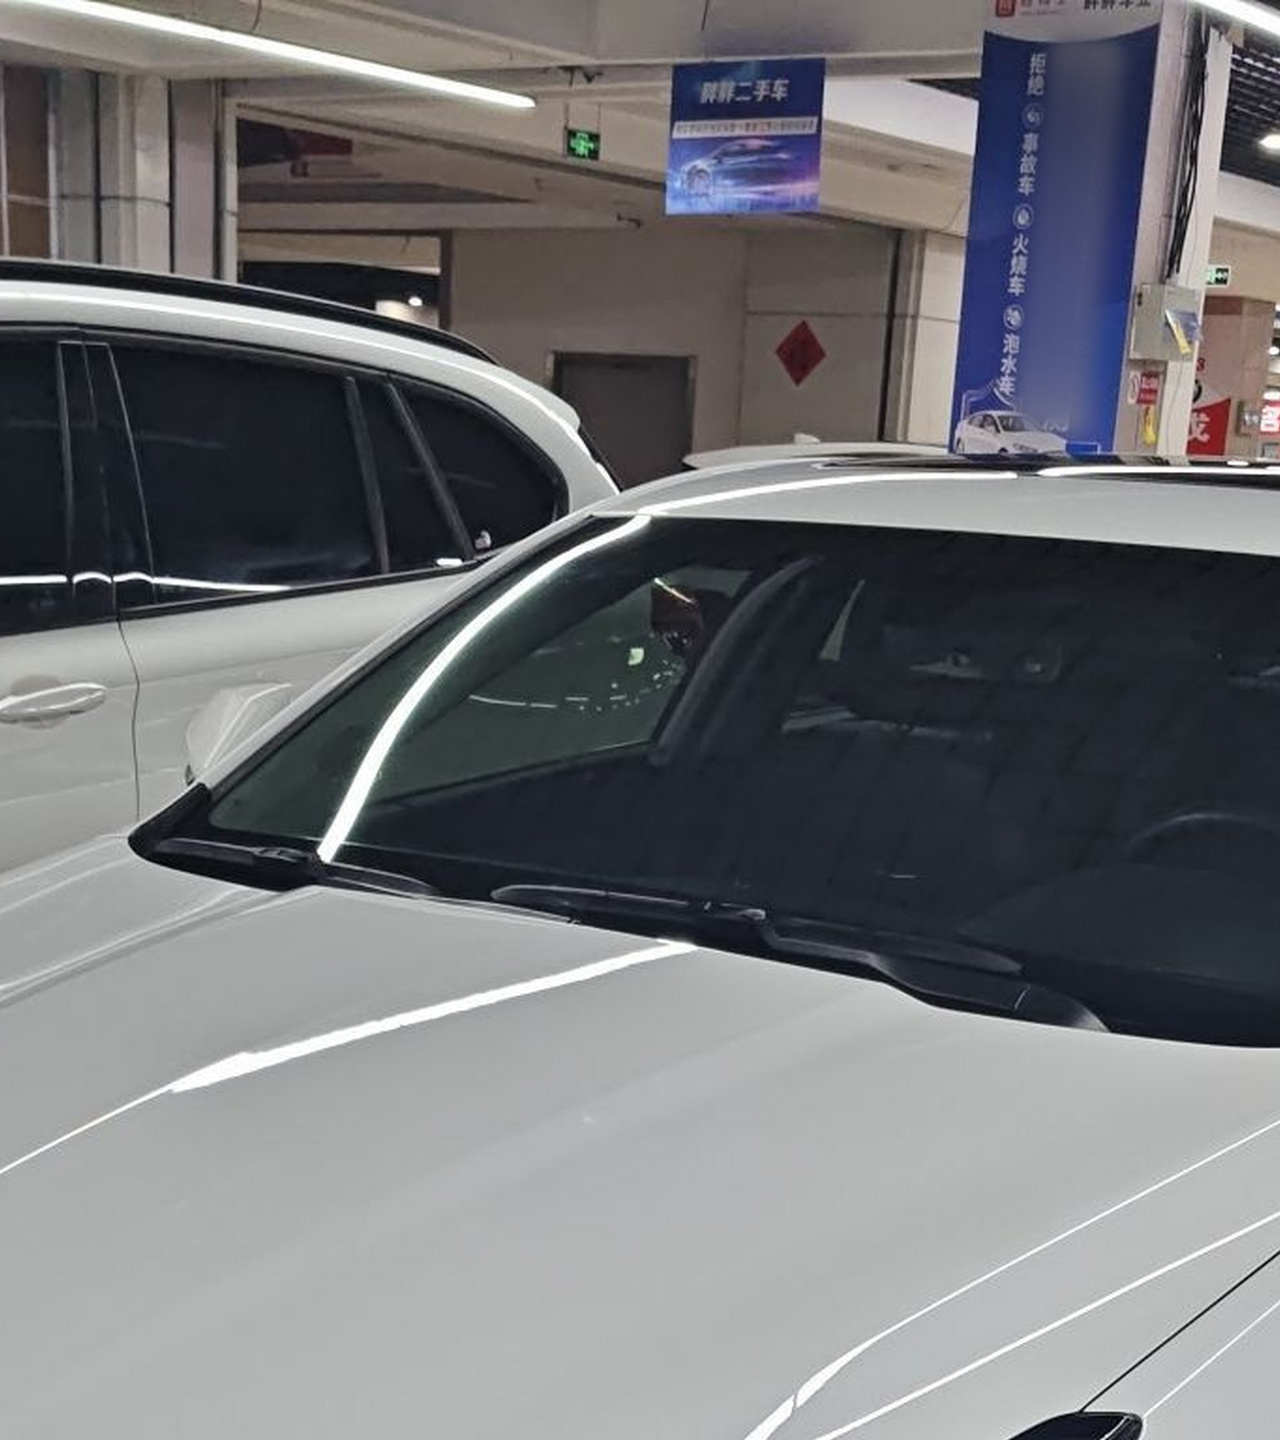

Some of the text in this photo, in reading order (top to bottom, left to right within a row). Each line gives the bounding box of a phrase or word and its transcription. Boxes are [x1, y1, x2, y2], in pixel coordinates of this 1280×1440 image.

[1027, 54, 1047, 96] 拒绝
[1018, 133, 1040, 195] 事故车
[1007, 233, 1028, 296] 火烧车
